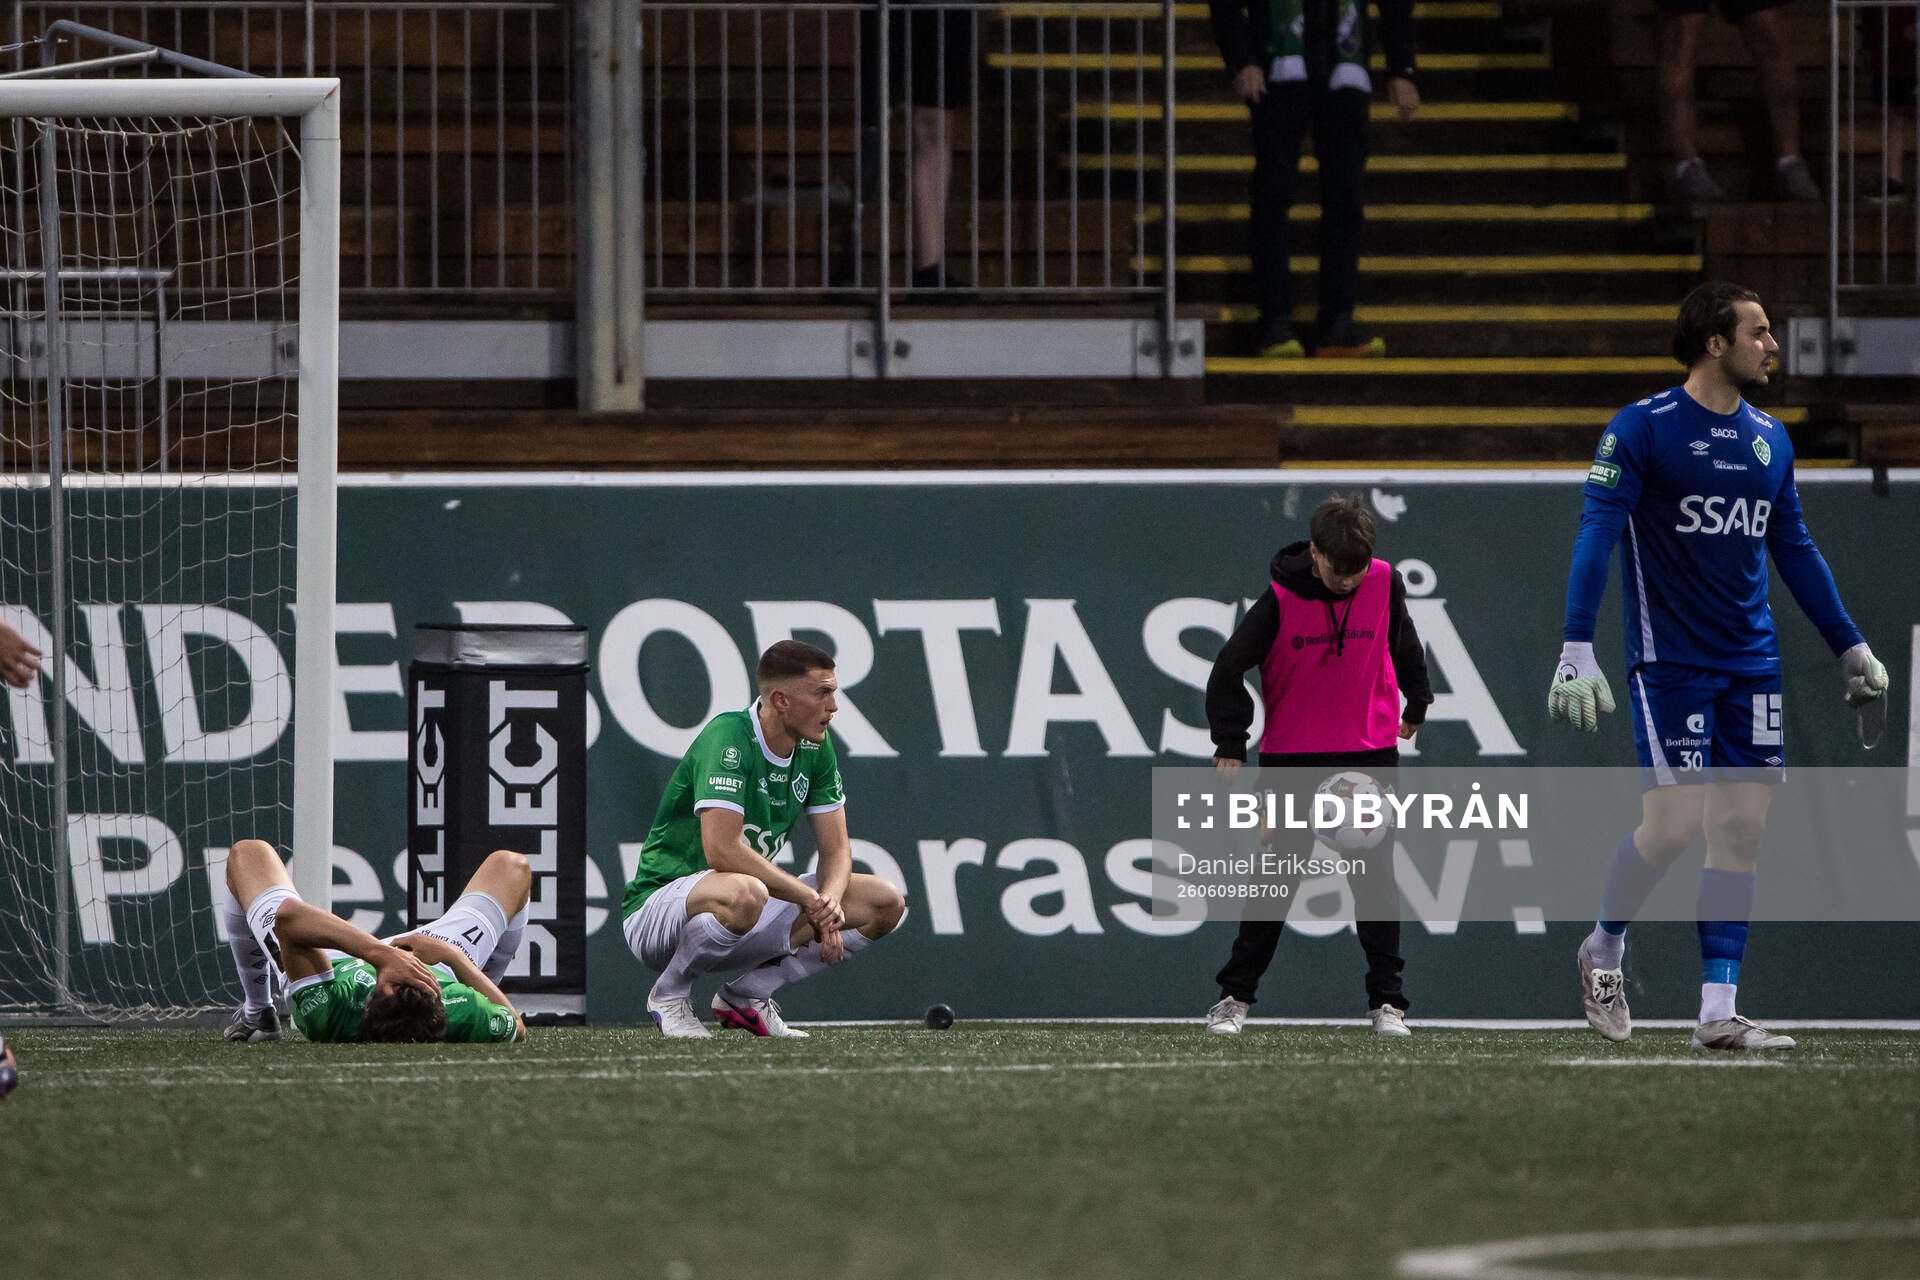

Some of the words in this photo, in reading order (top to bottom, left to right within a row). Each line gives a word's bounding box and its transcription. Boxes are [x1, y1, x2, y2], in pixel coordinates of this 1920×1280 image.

[1675, 495, 1772, 537] SSAB
[453, 558, 1527, 759] ORTASÅ
[1680, 750, 1703, 772] 30
[709, 776, 744, 789] UNIBET
[416, 680, 445, 927] ELECT
[461, 925, 485, 945] 17
